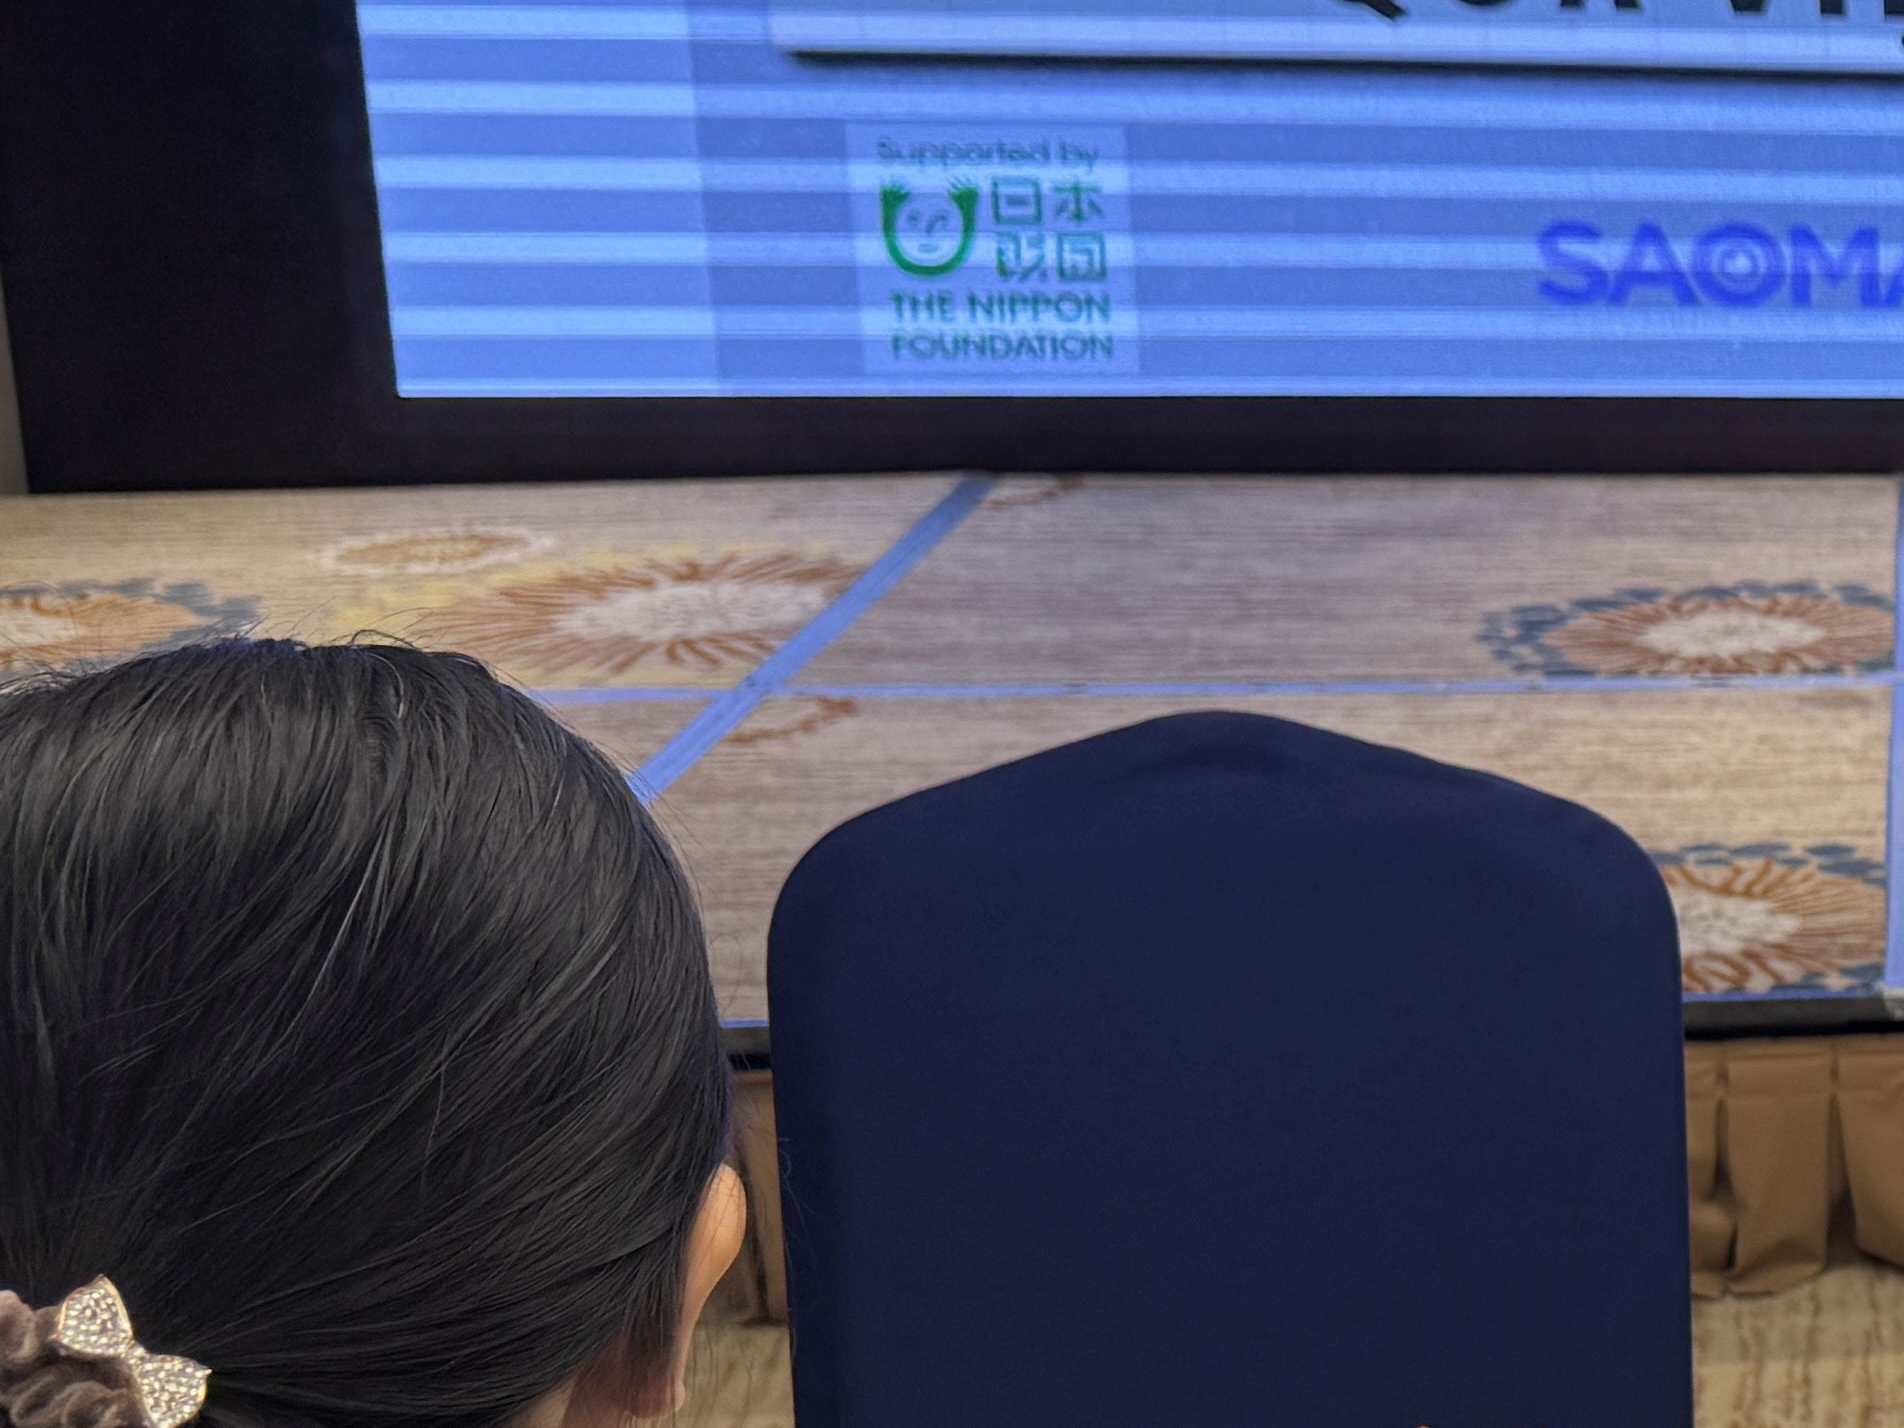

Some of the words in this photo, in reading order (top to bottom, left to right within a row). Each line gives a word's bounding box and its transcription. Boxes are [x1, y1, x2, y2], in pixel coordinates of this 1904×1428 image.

[875, 136, 1050, 168] Supported
[1059, 138, 1099, 170] by
[889, 291, 955, 324] THE
[967, 291, 1110, 325] NIPPON
[891, 330, 1114, 362] FOUNDATION
